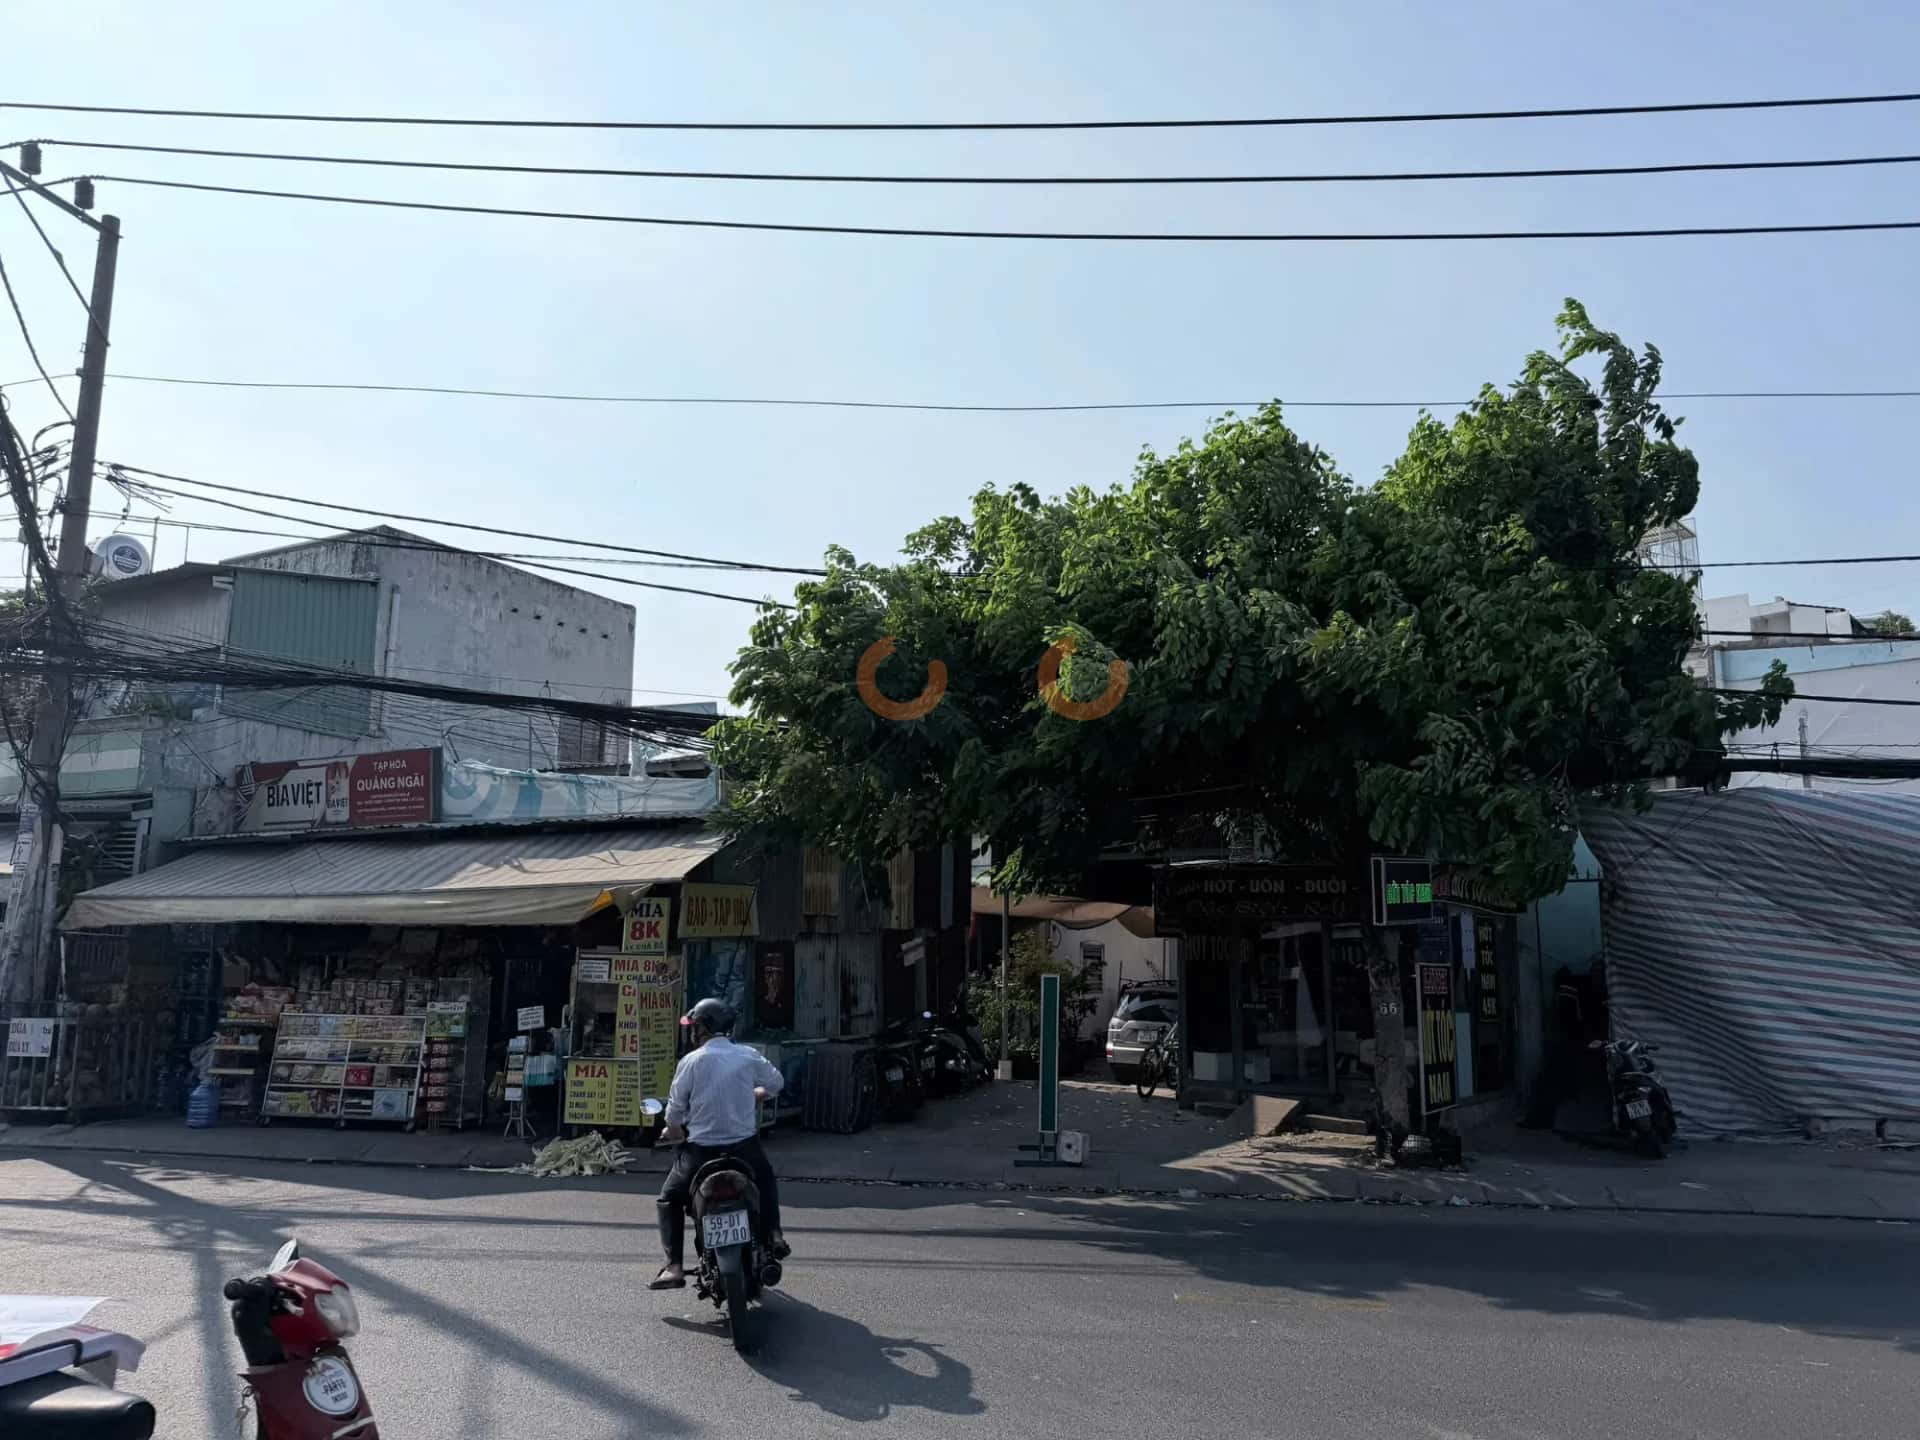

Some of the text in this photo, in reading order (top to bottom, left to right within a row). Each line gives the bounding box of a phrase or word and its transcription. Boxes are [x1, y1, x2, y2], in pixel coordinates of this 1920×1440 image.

[267, 779, 322, 808] BIA VIỆT
[630, 898, 664, 917] MÍA
[630, 920, 661, 941] 8K
[576, 1062, 608, 1078] MÍA
